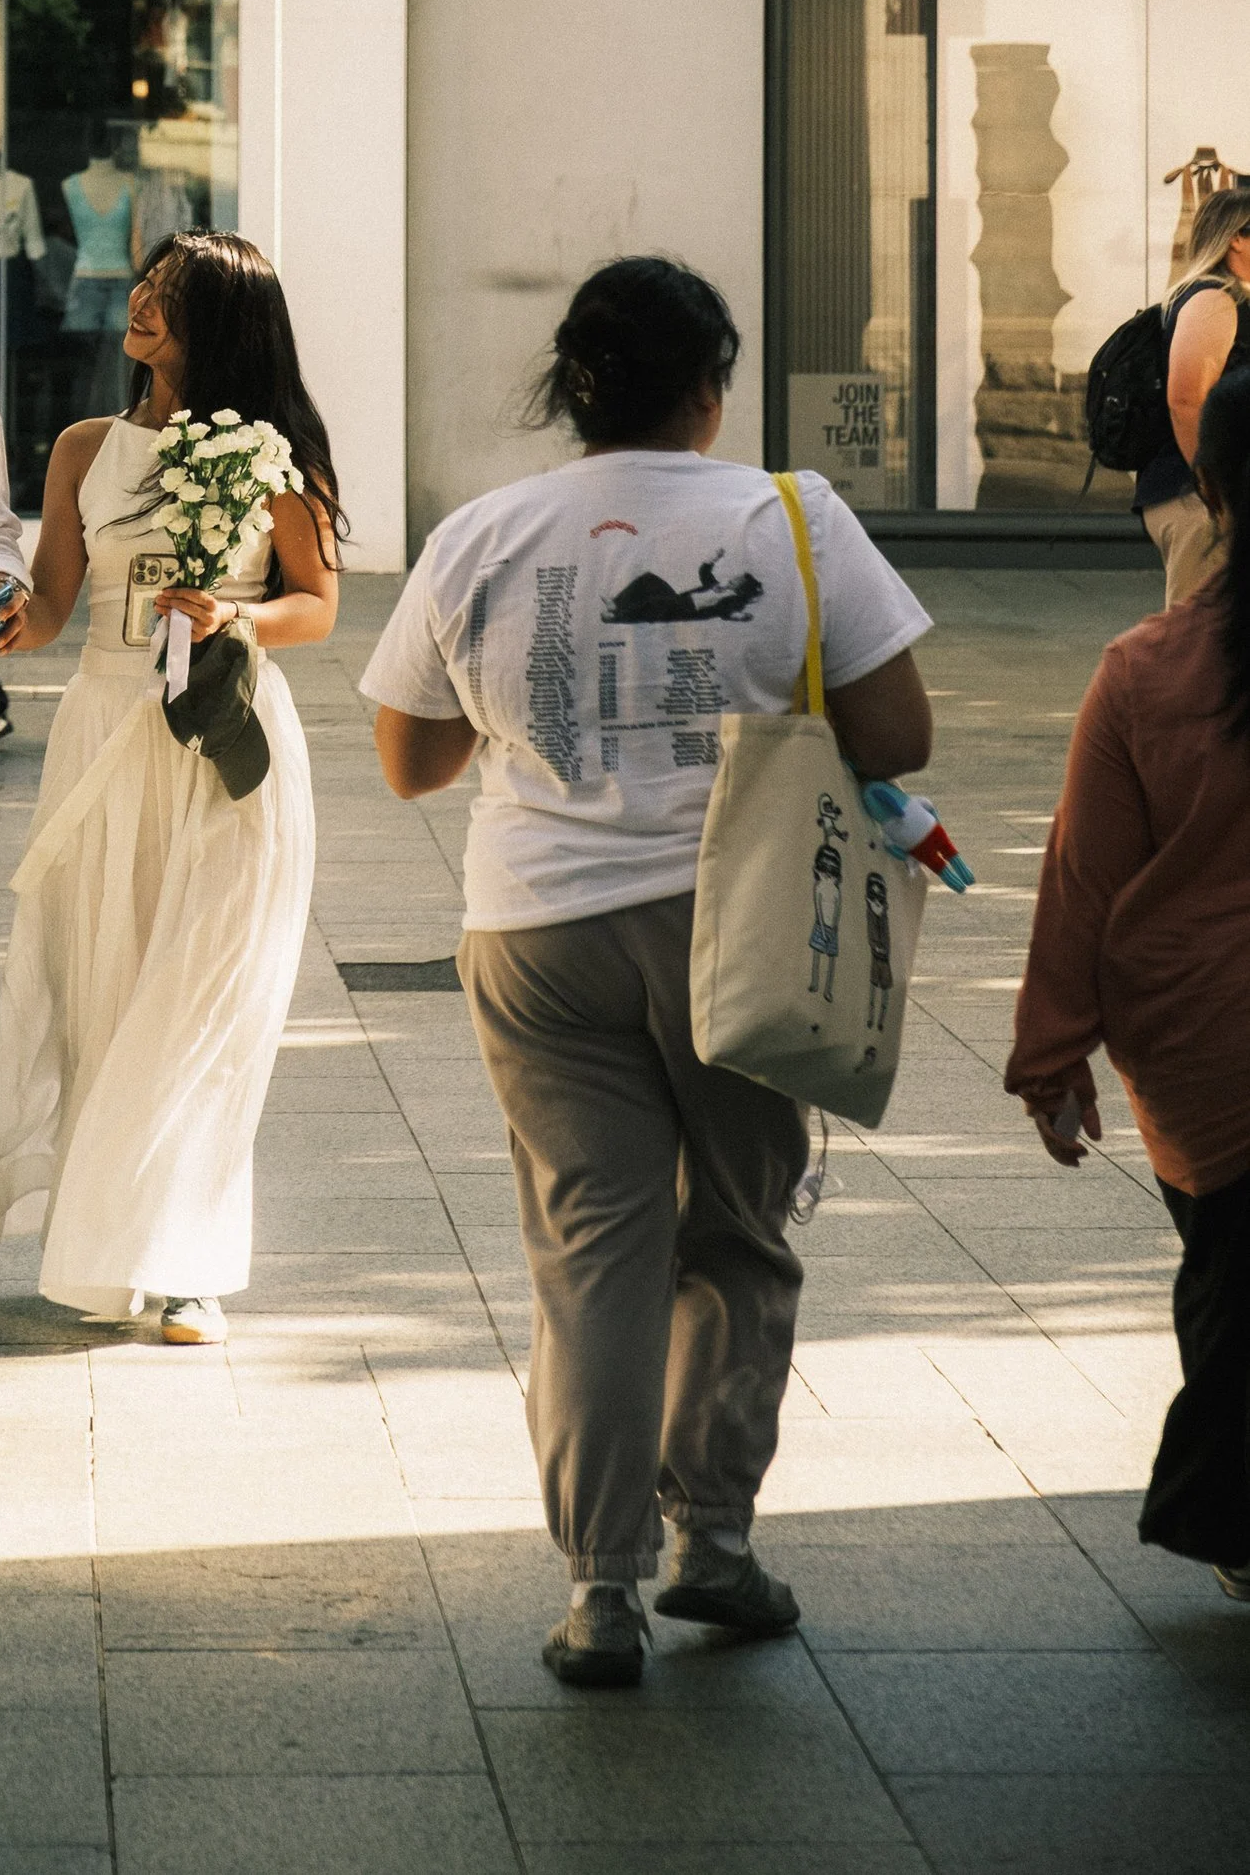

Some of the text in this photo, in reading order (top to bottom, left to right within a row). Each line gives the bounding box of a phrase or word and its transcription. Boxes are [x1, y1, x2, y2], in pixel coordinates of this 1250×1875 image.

[833, 384, 880, 404] JOIN
[840, 405, 880, 423] THE
[823, 426, 880, 446] TEAM
